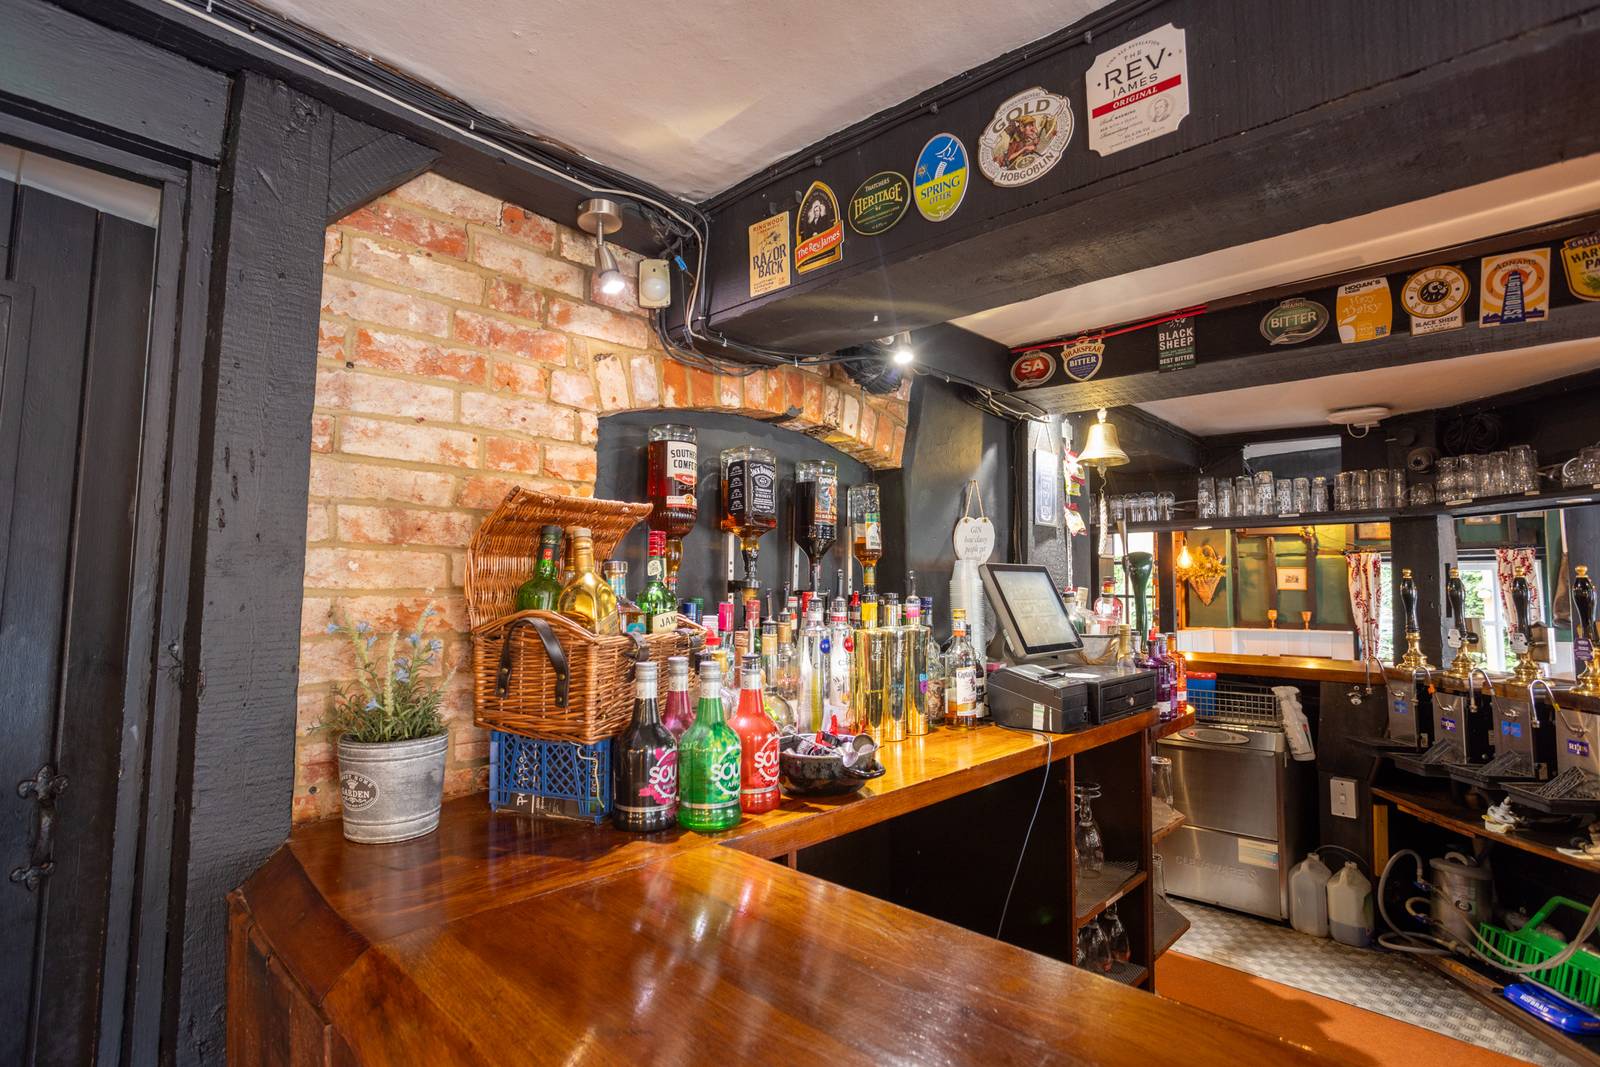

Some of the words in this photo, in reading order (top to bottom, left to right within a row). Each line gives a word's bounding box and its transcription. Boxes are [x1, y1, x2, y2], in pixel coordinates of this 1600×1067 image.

[1105, 47, 1166, 90] REV
[1112, 72, 1158, 99] JAMES
[1112, 86, 1158, 109] ORIGINAL
[992, 99, 1050, 134] GOLD
[1000, 151, 1055, 181] HOBGOBLIN
[865, 177, 890, 192] THATCHERS
[921, 176, 960, 201] SPRING
[854, 182, 903, 220] HERITAGE
[929, 190, 953, 205] OTTER
[753, 215, 784, 232] RINGWOOD
[798, 246, 809, 259] The
[820, 229, 840, 250] James
[752, 243, 787, 270] RAZOR
[1571, 247, 1600, 264] HAR
[757, 258, 784, 279] BACK
[1494, 259, 1537, 272] ADNAMS
[1345, 279, 1381, 292] HOGAN'S
[1503, 274, 1523, 320] LIGHTHOUSE
[1271, 311, 1317, 329] BITTER
[1415, 319, 1438, 328] BLACK
[1438, 315, 1458, 325] SHEEP
[1159, 327, 1193, 341] BLACK
[1063, 345, 1102, 359] BRAKSPEAR
[1159, 336, 1194, 351] SHEEP
[1021, 359, 1045, 373] SA
[1069, 356, 1097, 368] BITTER
[1160, 357, 1173, 365] BEST
[1175, 354, 1194, 363] BITTER
[660, 615, 677, 628] JAM
[754, 751, 780, 768] SOU
[649, 766, 677, 784] SOU
[711, 762, 740, 780] SOU
